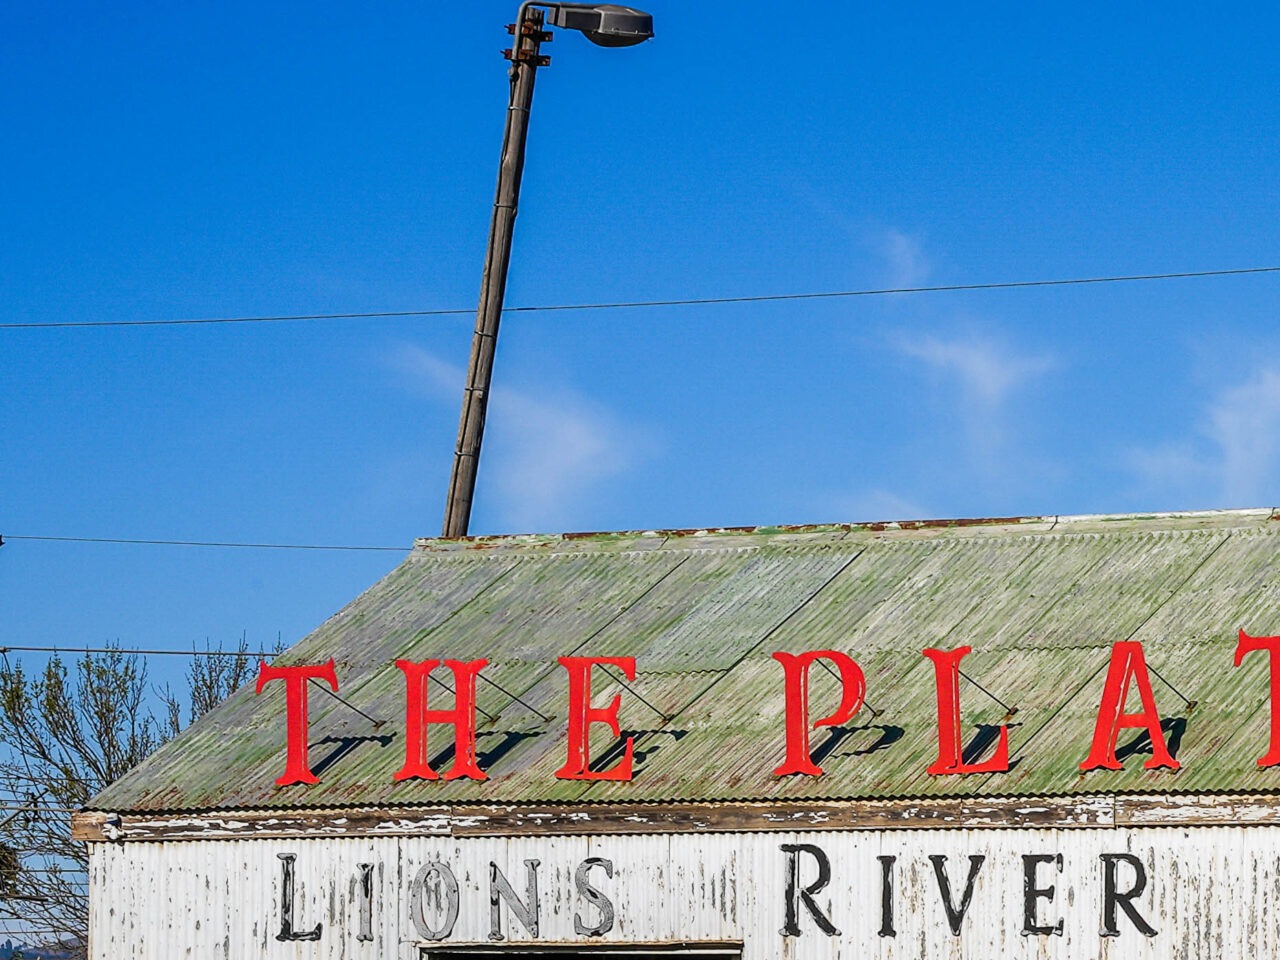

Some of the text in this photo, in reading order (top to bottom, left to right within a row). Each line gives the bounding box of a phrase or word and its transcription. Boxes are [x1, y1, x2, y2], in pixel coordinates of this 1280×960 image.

[256, 655, 638, 786] THE
[274, 852, 615, 942] LIONS
[778, 843, 1158, 938] RIVER
